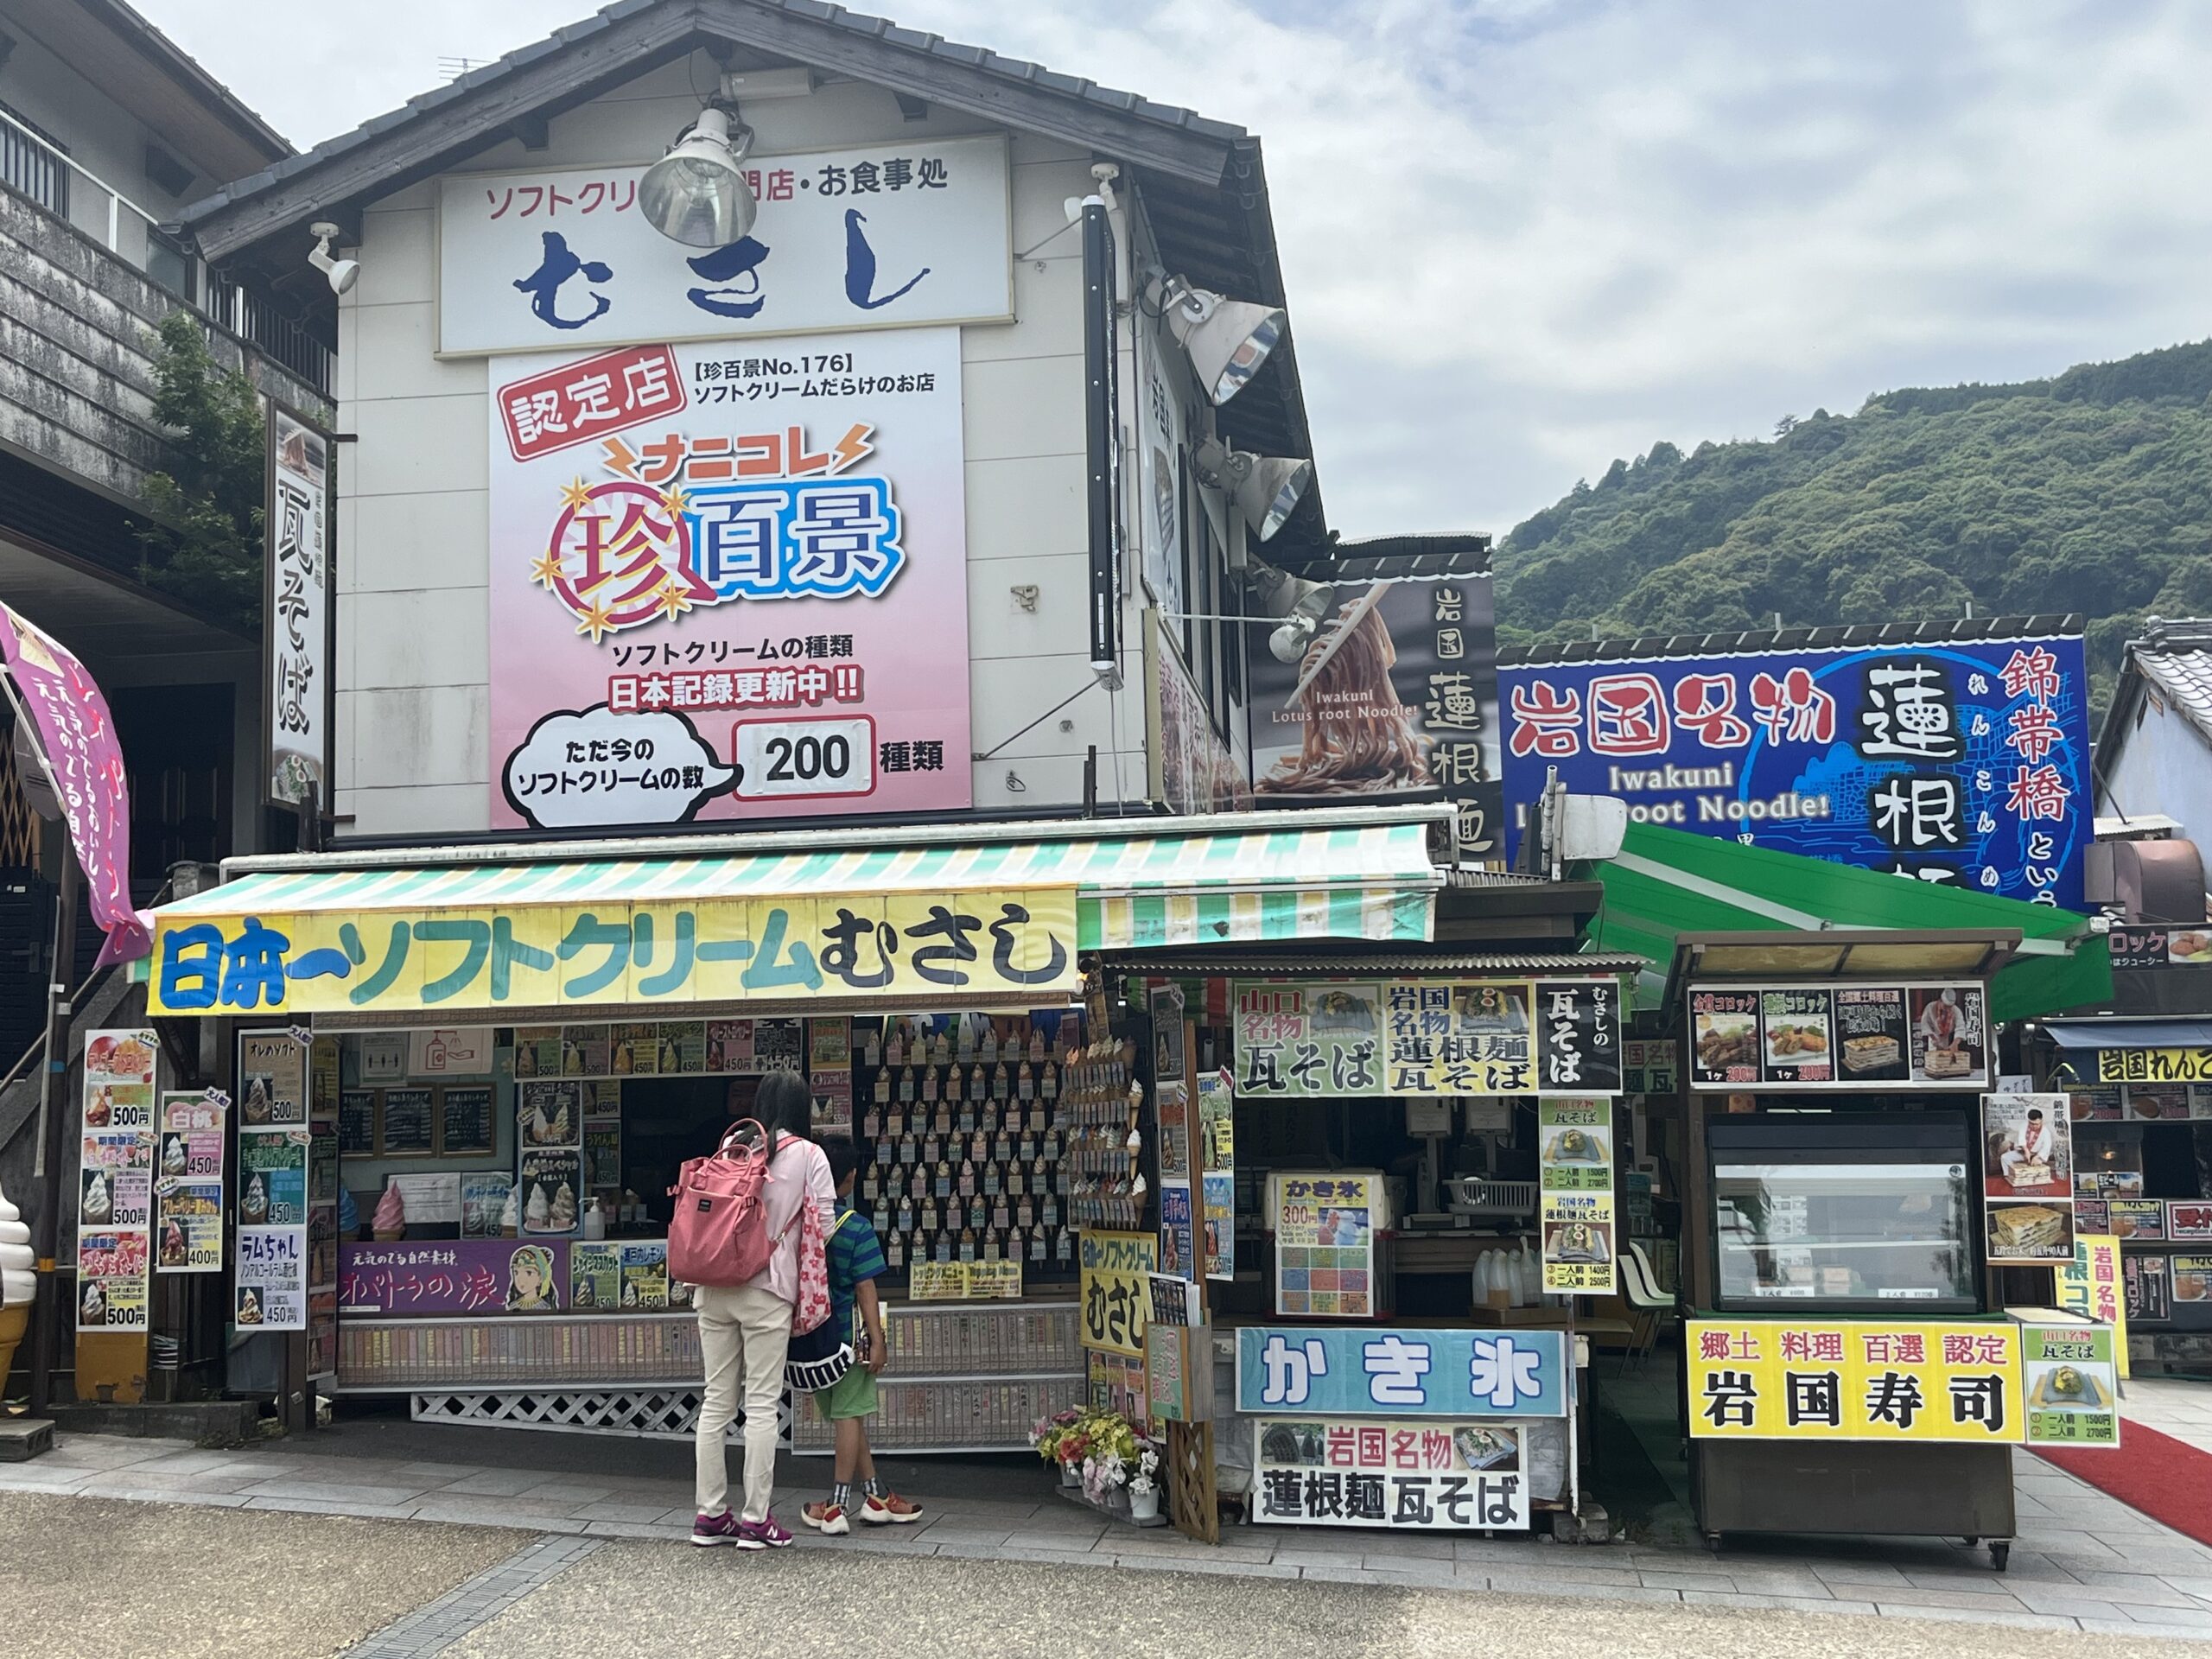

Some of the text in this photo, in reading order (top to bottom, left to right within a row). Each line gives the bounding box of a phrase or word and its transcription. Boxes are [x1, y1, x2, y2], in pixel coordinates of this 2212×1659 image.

[486, 158, 949, 219] ソフトクリ門店・お食事処
[513, 208, 931, 329] むさし
[511, 353, 671, 444] 認定店
[694, 372, 936, 404] ソフトクリームだらけのお店
[639, 427, 830, 480] ナニコレ
[573, 493, 887, 604] 珍百景
[277, 479, 314, 735] 瓦そば
[613, 634, 853, 667] ソフトクリームの種類
[1316, 690, 1374, 704] Iwakuni
[1272, 704, 1418, 723] Lotus root Noodle!
[1510, 667, 1835, 758] 岩国名物
[566, 738, 654, 764] ただ今の
[766, 734, 850, 781] 200
[880, 741, 944, 772] 種類
[518, 766, 704, 796] ソフトクリームの数
[1610, 761, 1733, 791] Iwakuni
[1628, 793, 1831, 824] oot Noodle!
[160, 903, 1067, 1008] 日本一ソフトクリームむさし
[1242, 989, 1300, 1014] 山口
[1388, 986, 1450, 1011] 岩国
[1242, 1014, 1301, 1041] 名物
[1389, 1012, 1451, 1036] 名物
[1592, 987, 1610, 1046] むさしの
[251, 1042, 296, 1057] オレのソフト
[1389, 1036, 1529, 1064] 蓮根麺
[1548, 988, 1582, 1084] 瓦そば
[1242, 1040, 1376, 1092] 瓦そば
[1390, 1063, 1530, 1091] 瓦そば
[113, 1106, 149, 1125] 500円
[173, 1110, 213, 1128] 白桃
[1555, 1111, 1597, 1123] 瓦そば
[188, 1156, 219, 1174] 450円
[1286, 1180, 1363, 1198] かき氷
[1557, 1198, 1596, 1208] 岩国名物
[114, 1209, 146, 1224] 500円
[1282, 1205, 1318, 1224] 300円
[188, 1249, 219, 1265] 400円
[242, 1235, 298, 1262] ラムちゃん
[2094, 1246, 2116, 1322] 岩国名物
[108, 1307, 145, 1325] 500円
[267, 1306, 297, 1323] 450円
[1087, 1274, 1147, 1349] むさし
[1700, 1332, 2008, 1365] 郷土 料理 百選 認定
[2042, 1330, 2092, 1343] 山口名物
[2041, 1344, 2094, 1360] 瓦そば
[1262, 1334, 1542, 1408] かき氷
[1703, 1370, 2005, 1432] 岩国寿司
[1327, 1427, 1452, 1470] 岩国名物
[1262, 1470, 1519, 1524] 蓮根麺瓦そば
